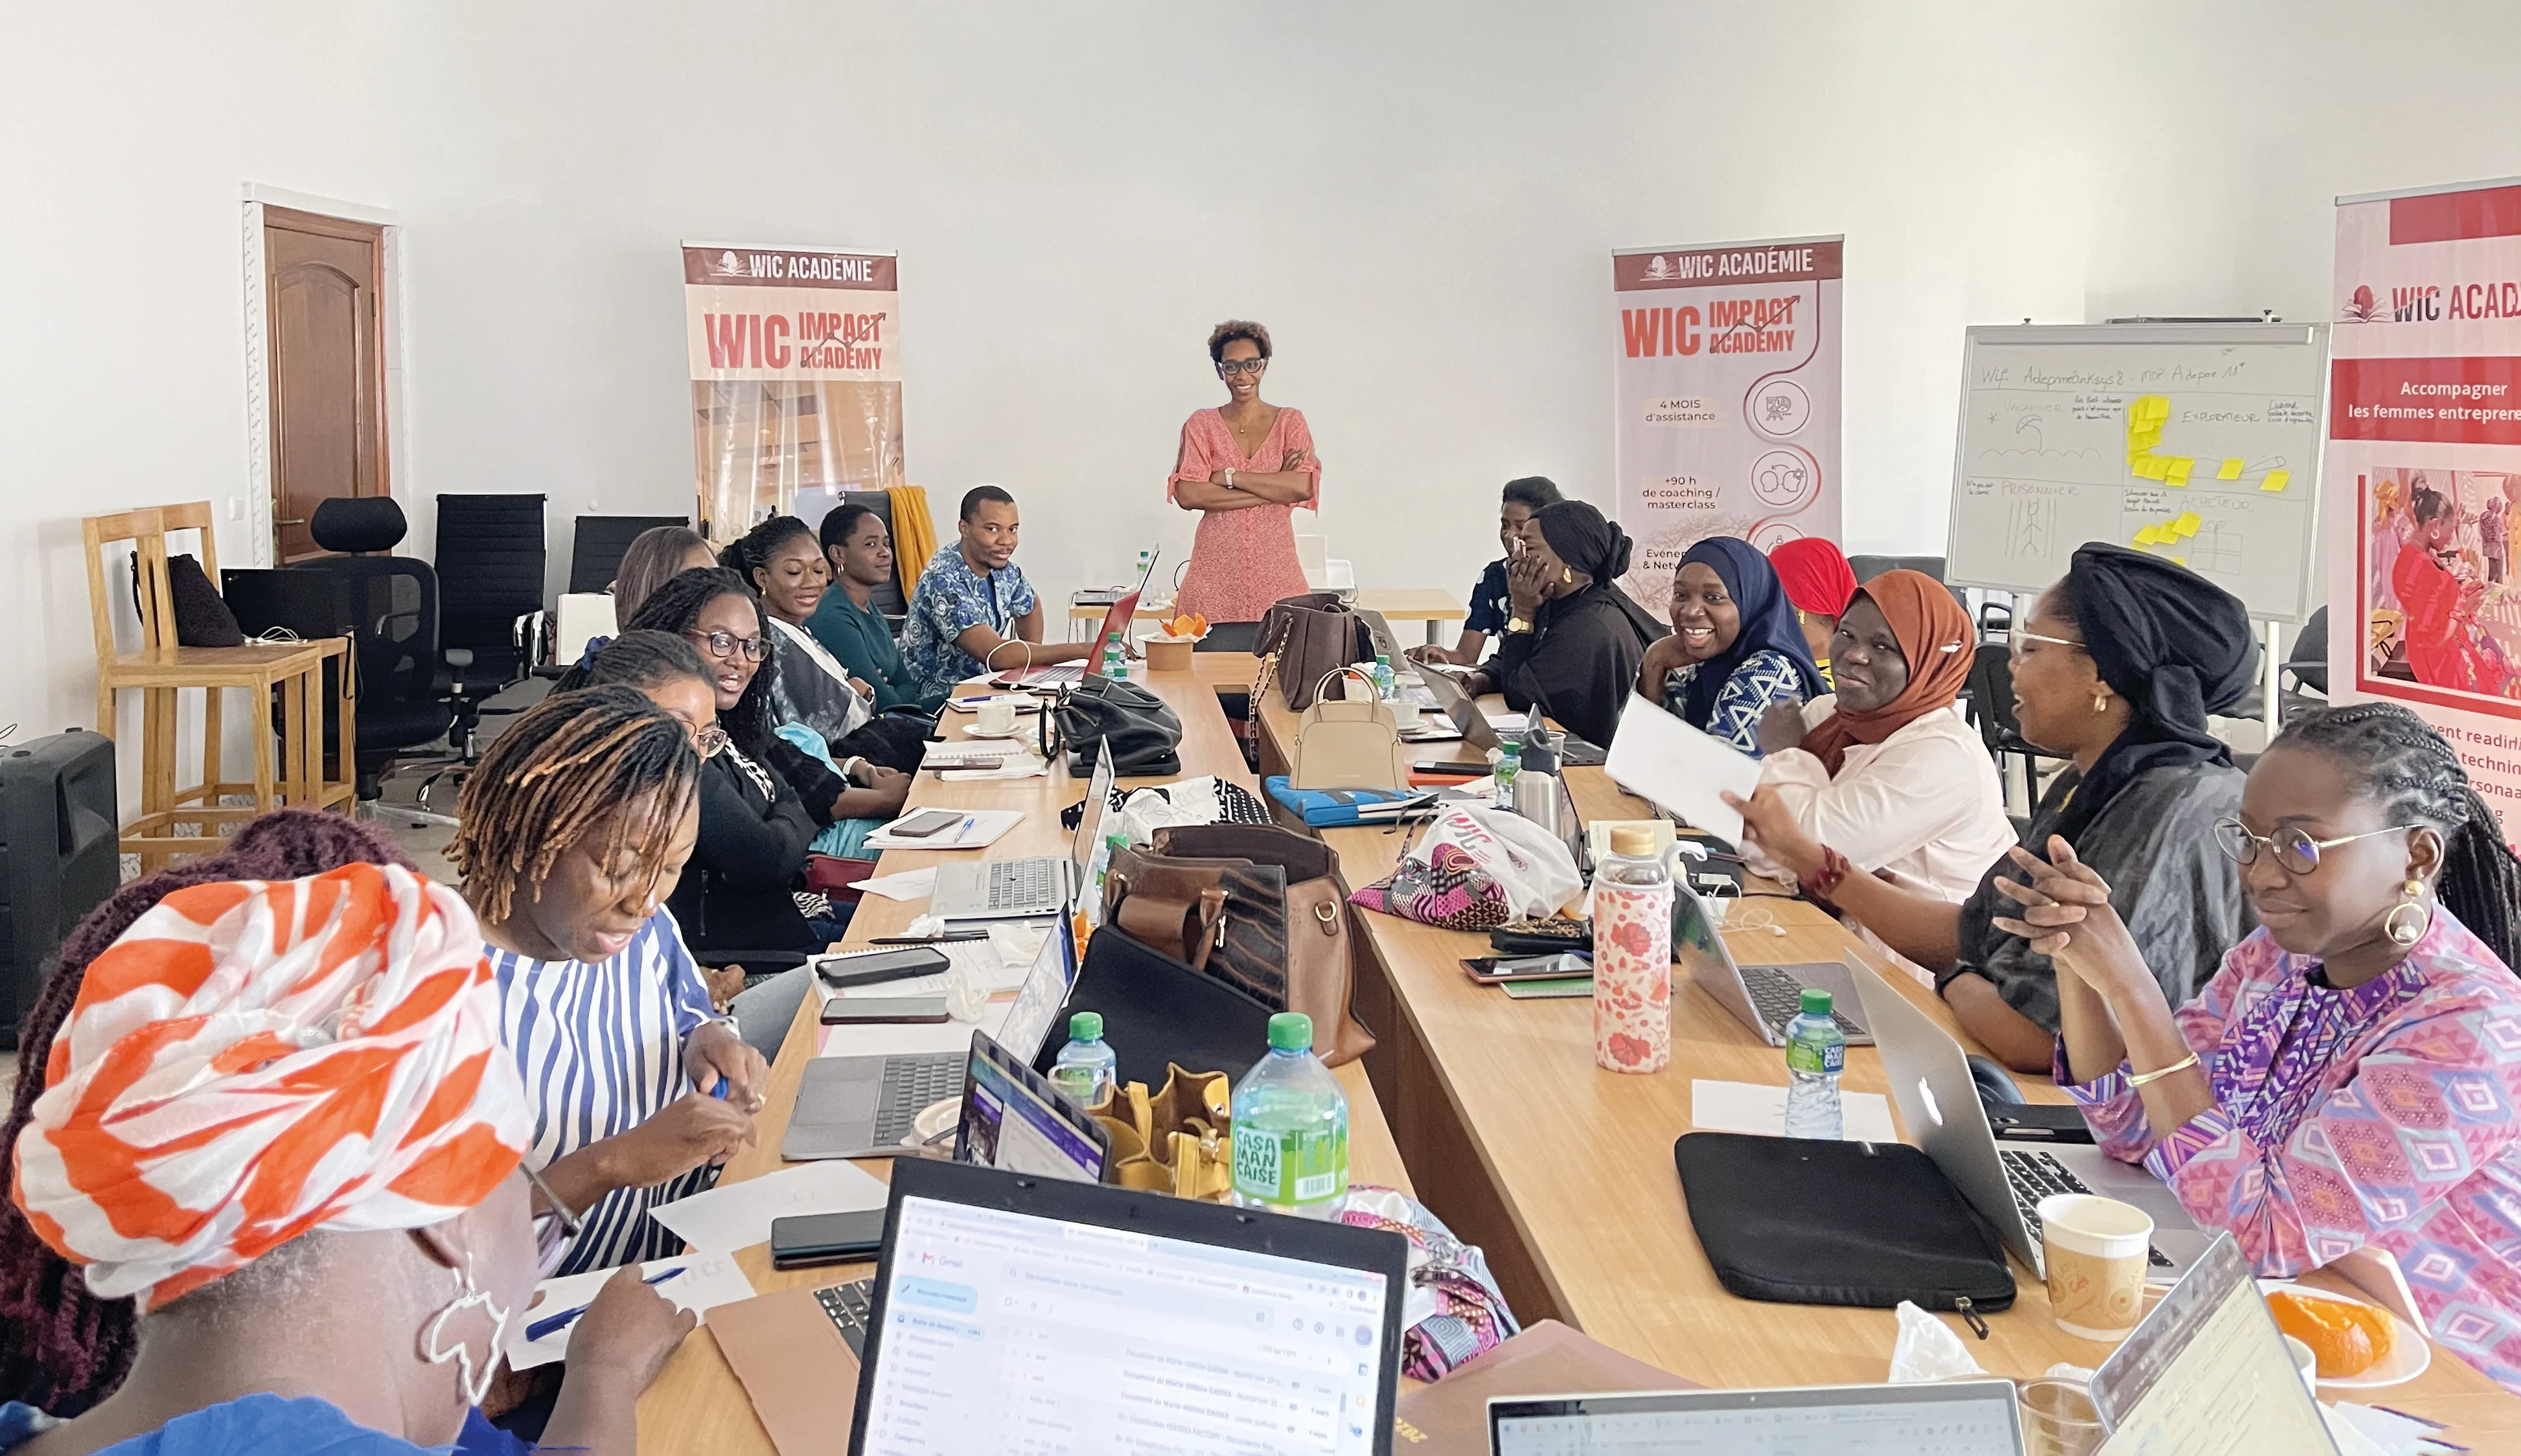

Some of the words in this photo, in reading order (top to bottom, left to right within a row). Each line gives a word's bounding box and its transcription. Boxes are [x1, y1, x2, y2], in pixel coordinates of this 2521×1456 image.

[749, 255, 783, 278] WIC
[788, 254, 873, 281] ACADÉMIE
[1679, 255, 1714, 279] WIC
[1718, 246, 1813, 277] ACADÉMIE
[1709, 297, 1793, 328] IMPACT
[2392, 286, 2440, 322] WIC
[2448, 282, 2521, 319] ACAD
[799, 312, 881, 341] IMPACT
[1622, 306, 1701, 358] WIC
[704, 313, 791, 369] WIC
[1709, 330, 1795, 354] ACADEMY
[800, 346, 882, 369] ACADEMY
[2400, 381, 2508, 400] Accompagner
[1660, 400, 1667, 409] 4
[1670, 400, 1701, 409] MOIS
[2349, 404, 2369, 418] les
[2374, 404, 2435, 419] femmes
[1646, 411, 1716, 422] d'assistance
[2181, 411, 2260, 423] EXPLORATEUR
[1666, 476, 1686, 485] +90
[1689, 476, 1696, 485] h
[2001, 479, 2080, 496] PRISONNIER
[1642, 488, 1657, 497] de
[1660, 488, 1713, 499] coaching
[1716, 487, 1721, 498] /
[2178, 494, 2255, 512] ACHETEUR
[1642, 560, 1650, 569] &
[1236, 1130, 1276, 1153] CASA
[1237, 1145, 1276, 1168] MAN
[939, 1255, 963, 1269] Gmail
